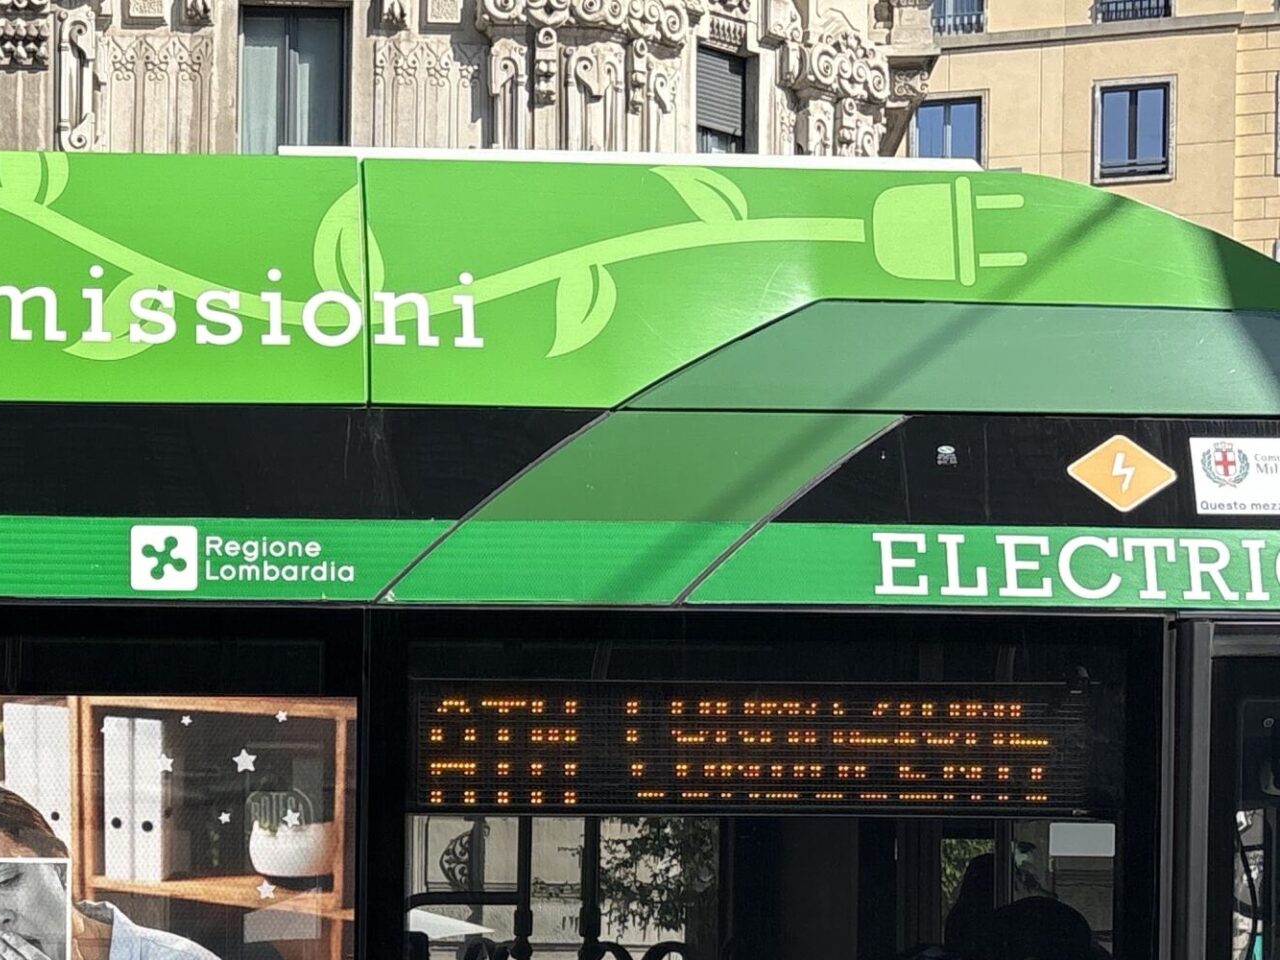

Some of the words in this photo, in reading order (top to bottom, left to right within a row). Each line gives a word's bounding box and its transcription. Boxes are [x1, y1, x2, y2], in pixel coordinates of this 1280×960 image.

[1201, 500, 1247, 511] Questo
[205, 536, 322, 561] Regione
[205, 559, 355, 583] Lombardia
[873, 532, 1280, 602] ELECTRI
